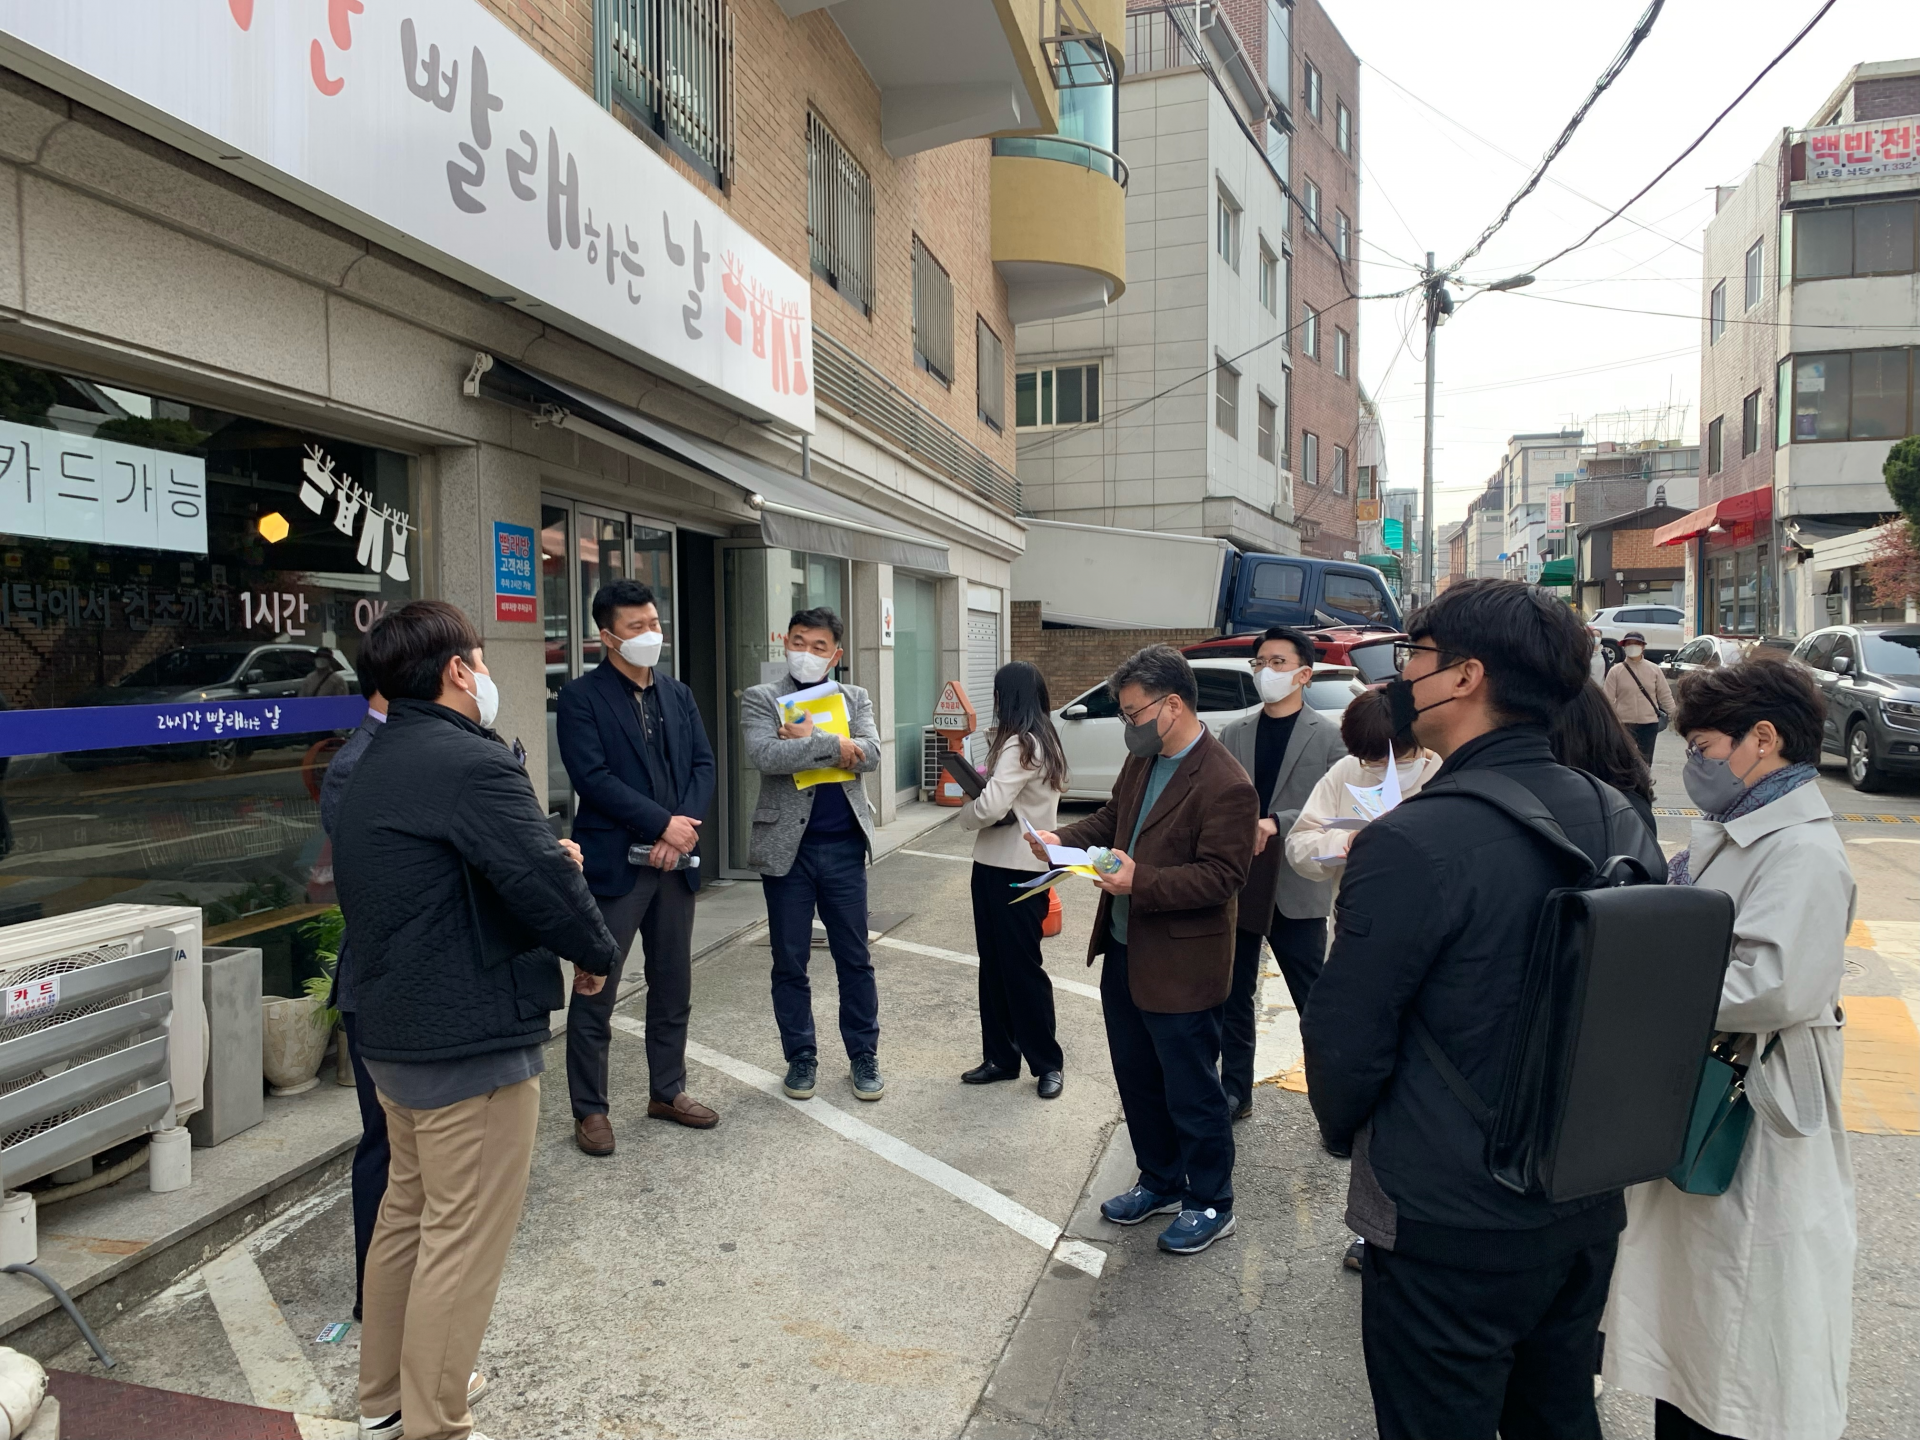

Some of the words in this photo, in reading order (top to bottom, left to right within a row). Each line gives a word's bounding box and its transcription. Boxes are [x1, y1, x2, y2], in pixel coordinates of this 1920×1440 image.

[1812, 125, 1920, 165] 백반전
[402, 18, 645, 306] 빨래하는
[664, 210, 711, 340] 날
[499, 532, 530, 558] 빨래방
[501, 558, 531, 577] 고객전용
[240, 591, 309, 636] 1시간
[157, 710, 201, 731] 24시간
[206, 707, 261, 734] 빨래하는
[265, 704, 281, 730] 날
[944, 717, 958, 725] GLS
